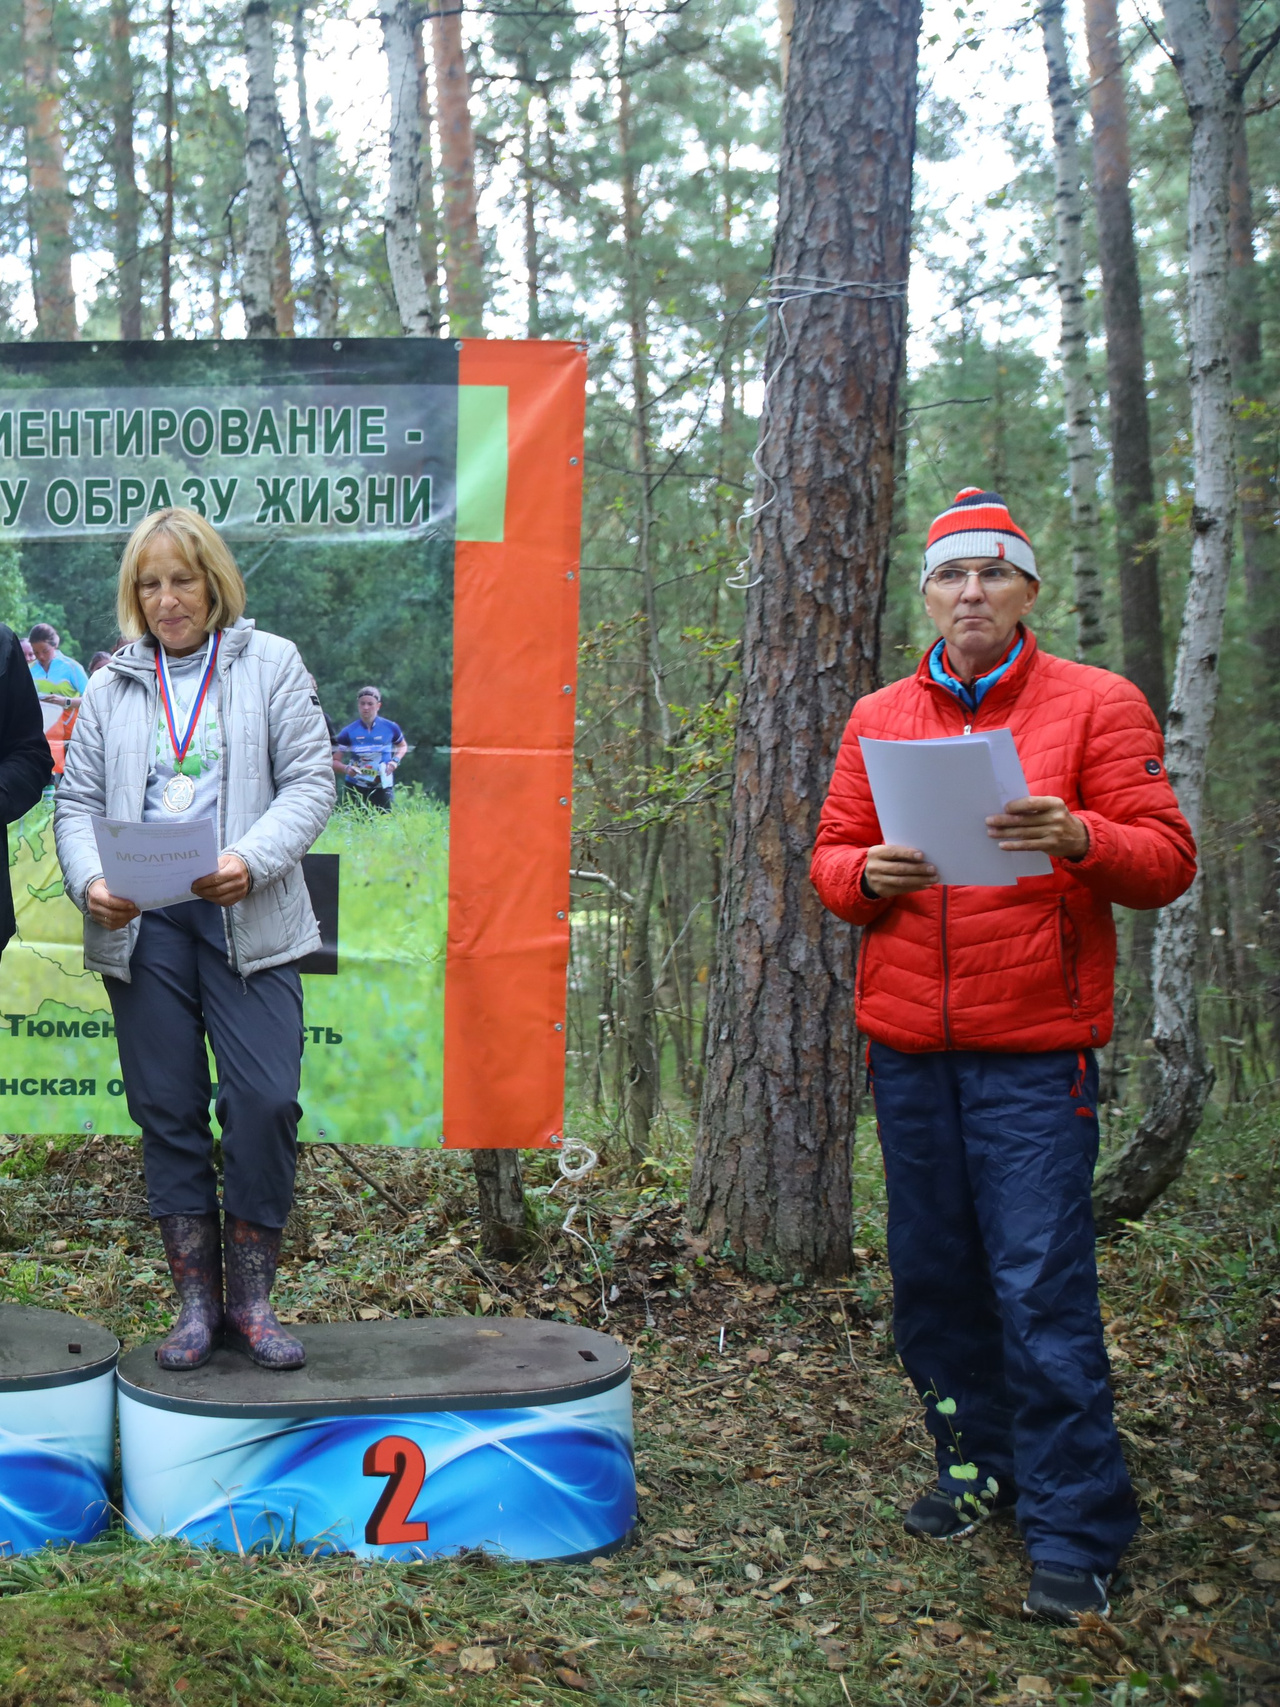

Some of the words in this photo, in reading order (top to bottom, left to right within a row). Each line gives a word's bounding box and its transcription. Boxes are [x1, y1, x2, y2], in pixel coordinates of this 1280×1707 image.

[46, 477, 239, 527] ОБРАЗУ
[255, 476, 431, 525] ЖИЗНИ
[4, 1013, 118, 1038] Тюмен
[362, 1434, 429, 1545] 2
